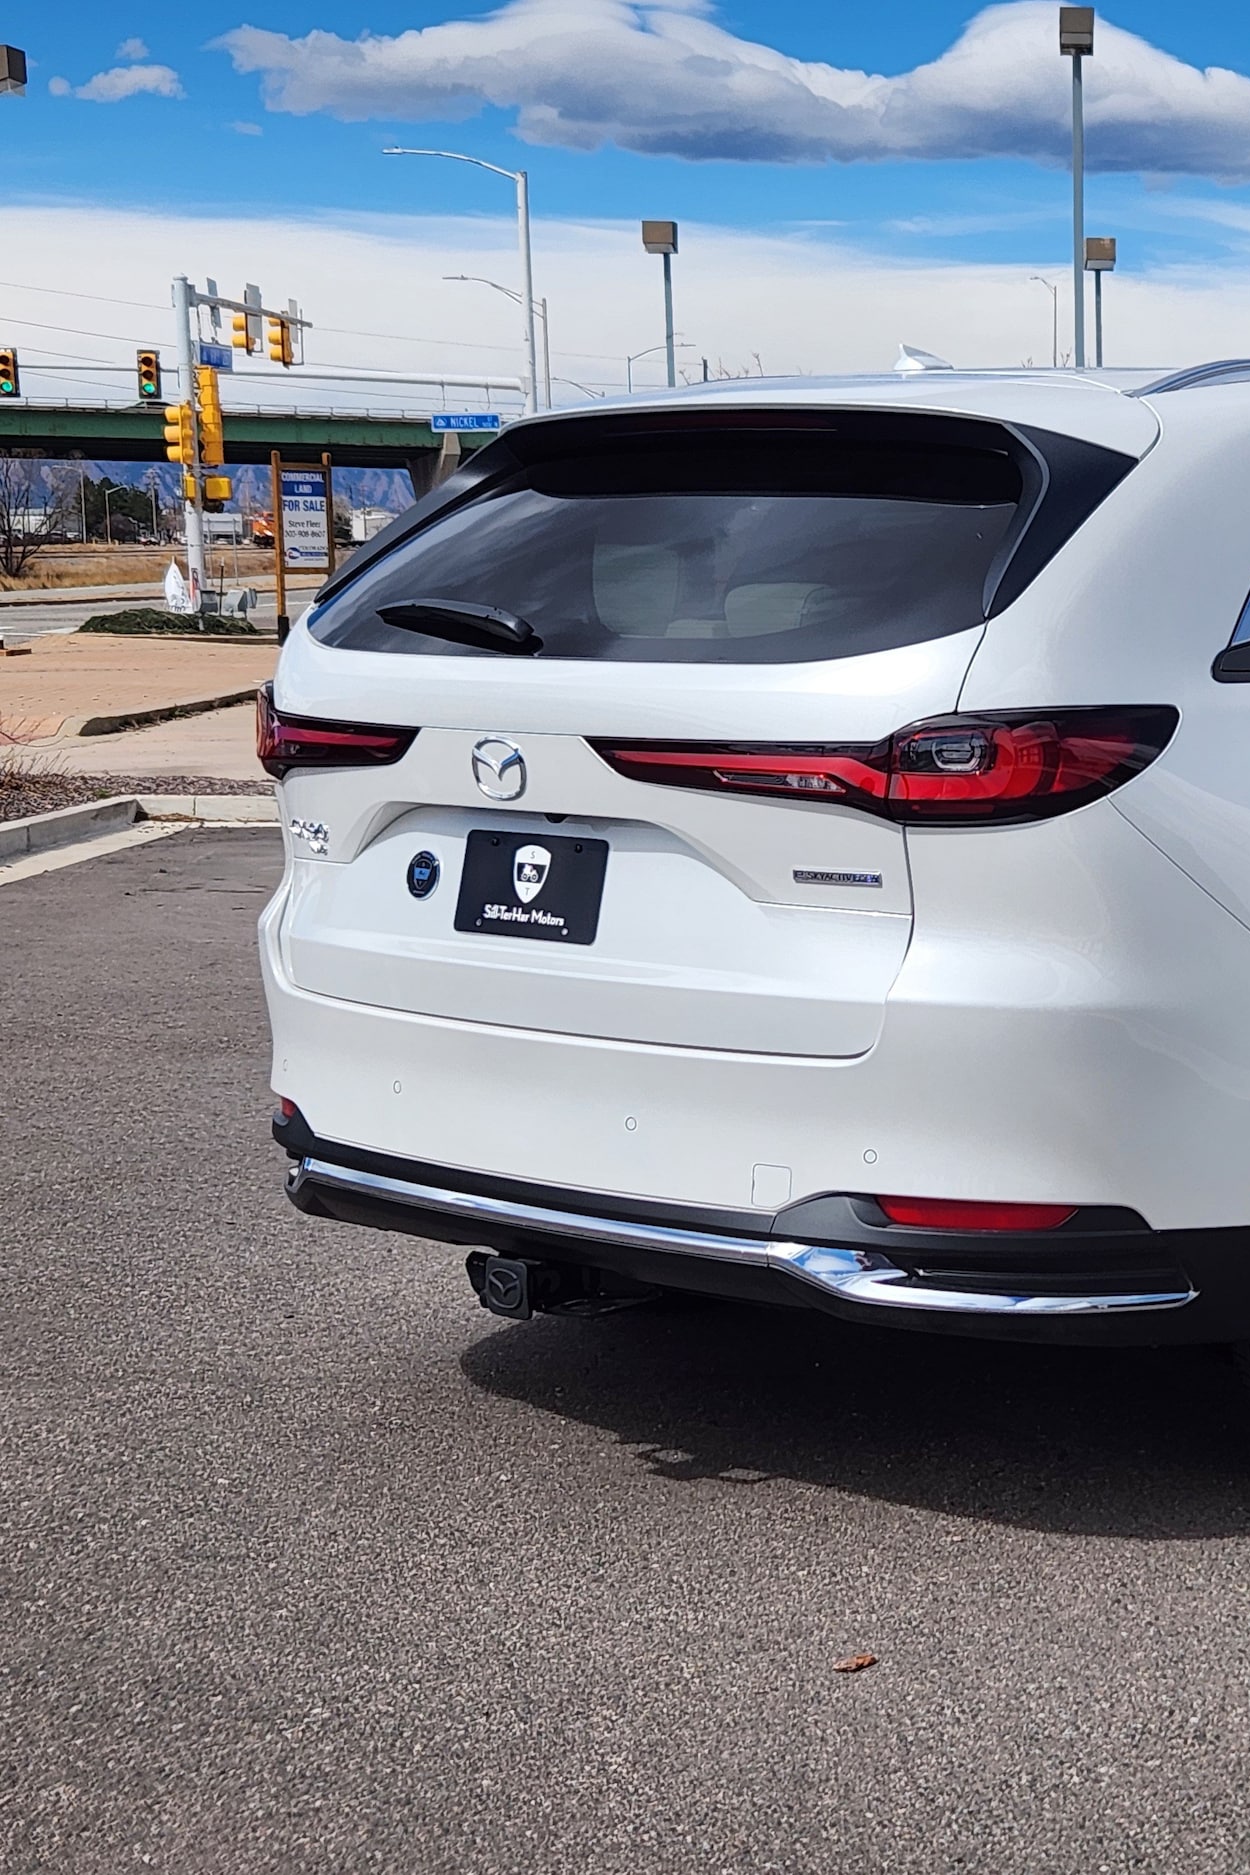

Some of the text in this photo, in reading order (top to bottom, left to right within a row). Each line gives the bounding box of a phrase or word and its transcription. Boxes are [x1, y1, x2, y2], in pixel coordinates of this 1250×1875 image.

[450, 416, 479, 428] NICKEL
[281, 472, 325, 482] COMMERCIAL
[294, 484, 312, 493] LAND
[282, 500, 325, 512] FOR SALE
[530, 851, 536, 859] S
[525, 887, 530, 896] T
[531, 909, 565, 926] Motors
